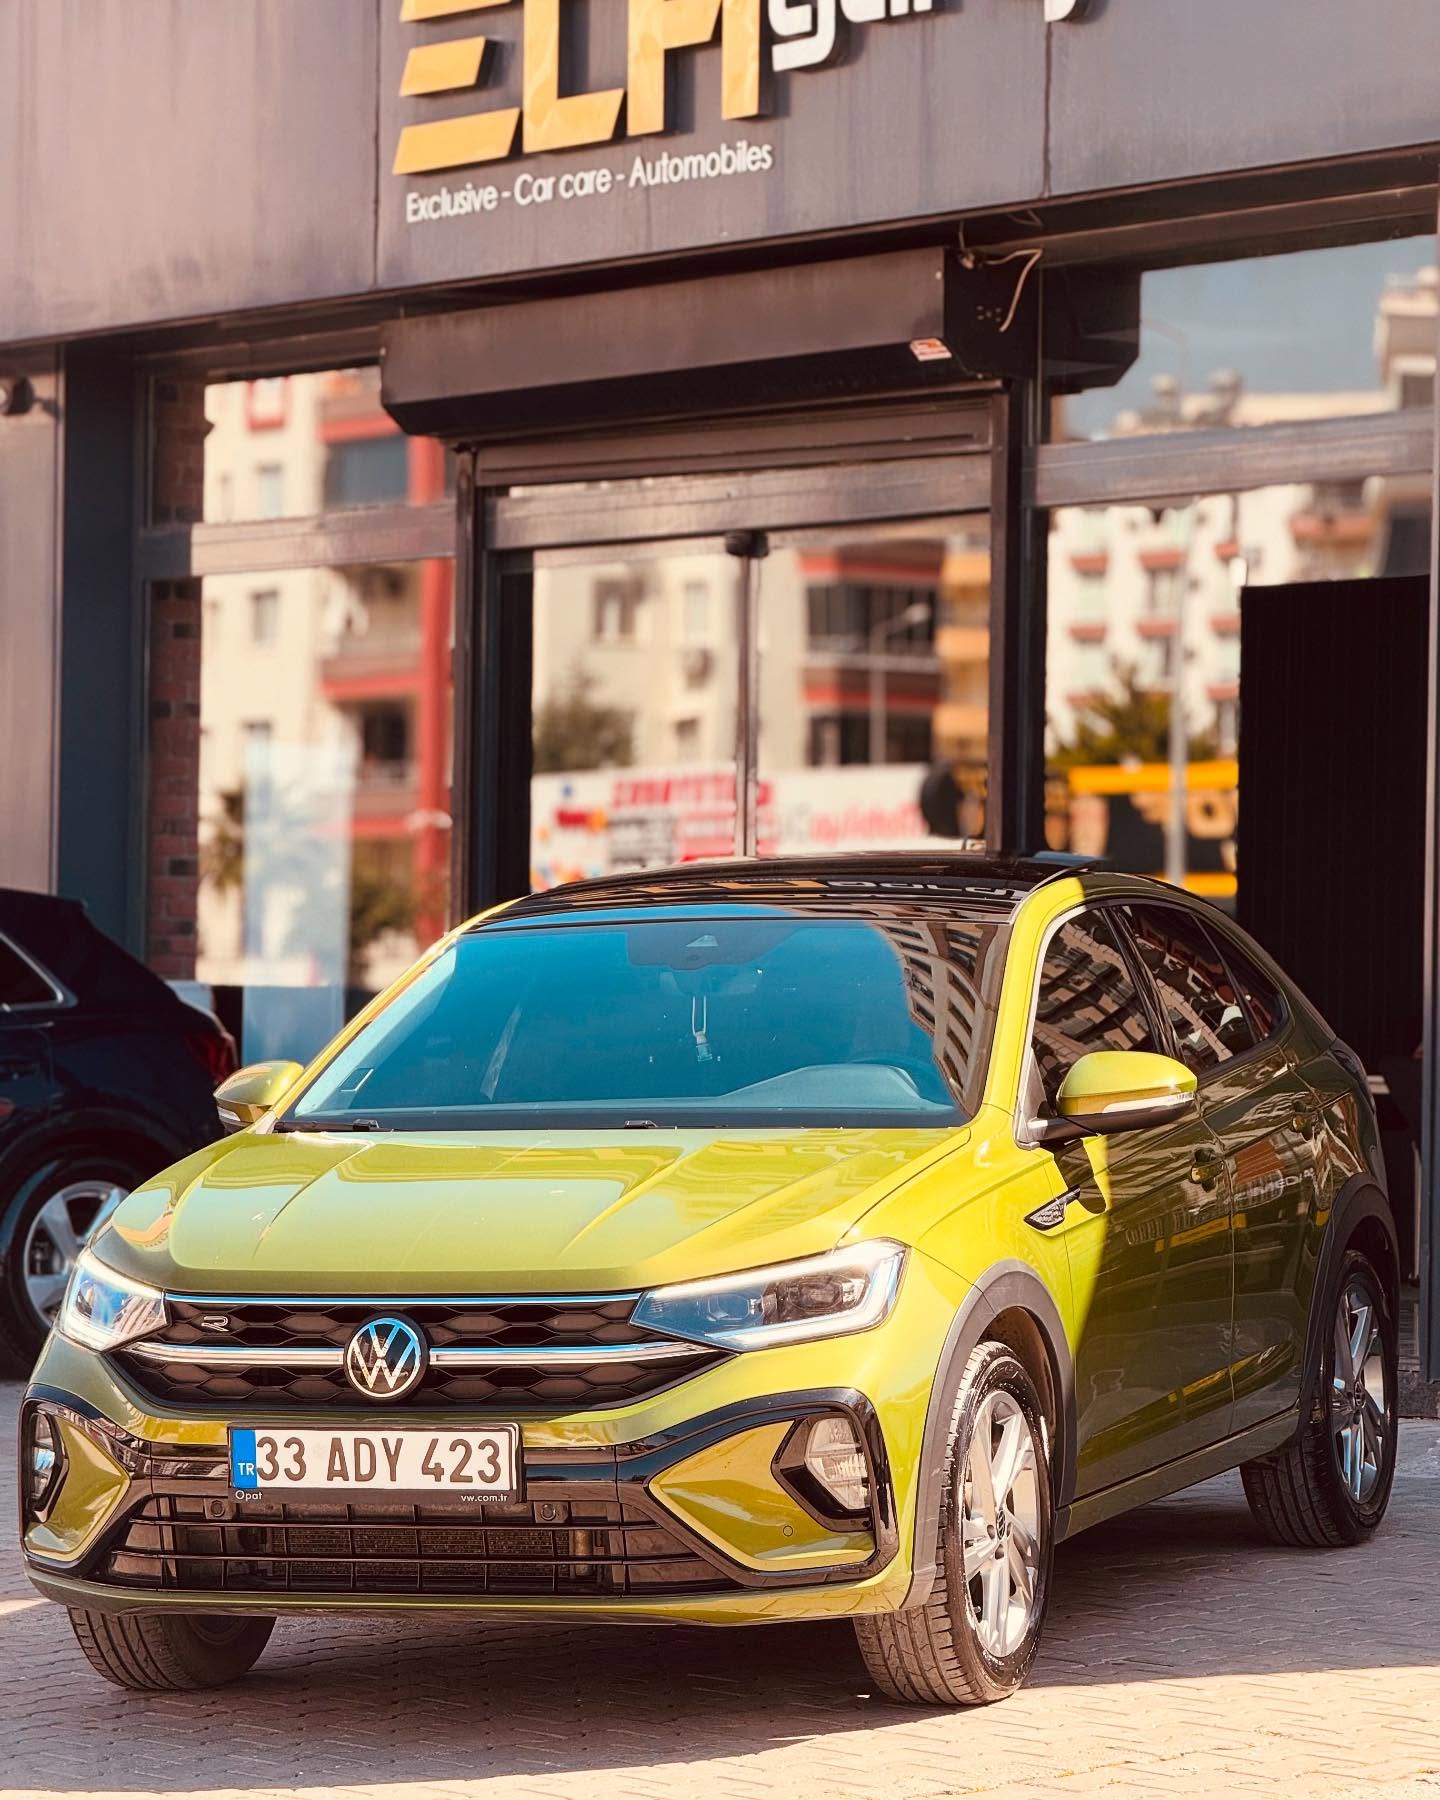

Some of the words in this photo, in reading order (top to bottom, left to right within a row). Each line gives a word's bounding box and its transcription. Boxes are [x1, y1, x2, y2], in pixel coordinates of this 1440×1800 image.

[406, 182, 498, 223] Exclusive
[514, 173, 556, 206] Car
[559, 167, 612, 200] care
[628, 140, 773, 188] Automobiles
[237, 1462, 255, 1476] TR
[257, 1436, 307, 1481] 33
[326, 1437, 404, 1482] ADY
[421, 1438, 502, 1483] 423
[235, 1490, 263, 1501] Opat
[460, 1493, 508, 1502] vw.com.tr
